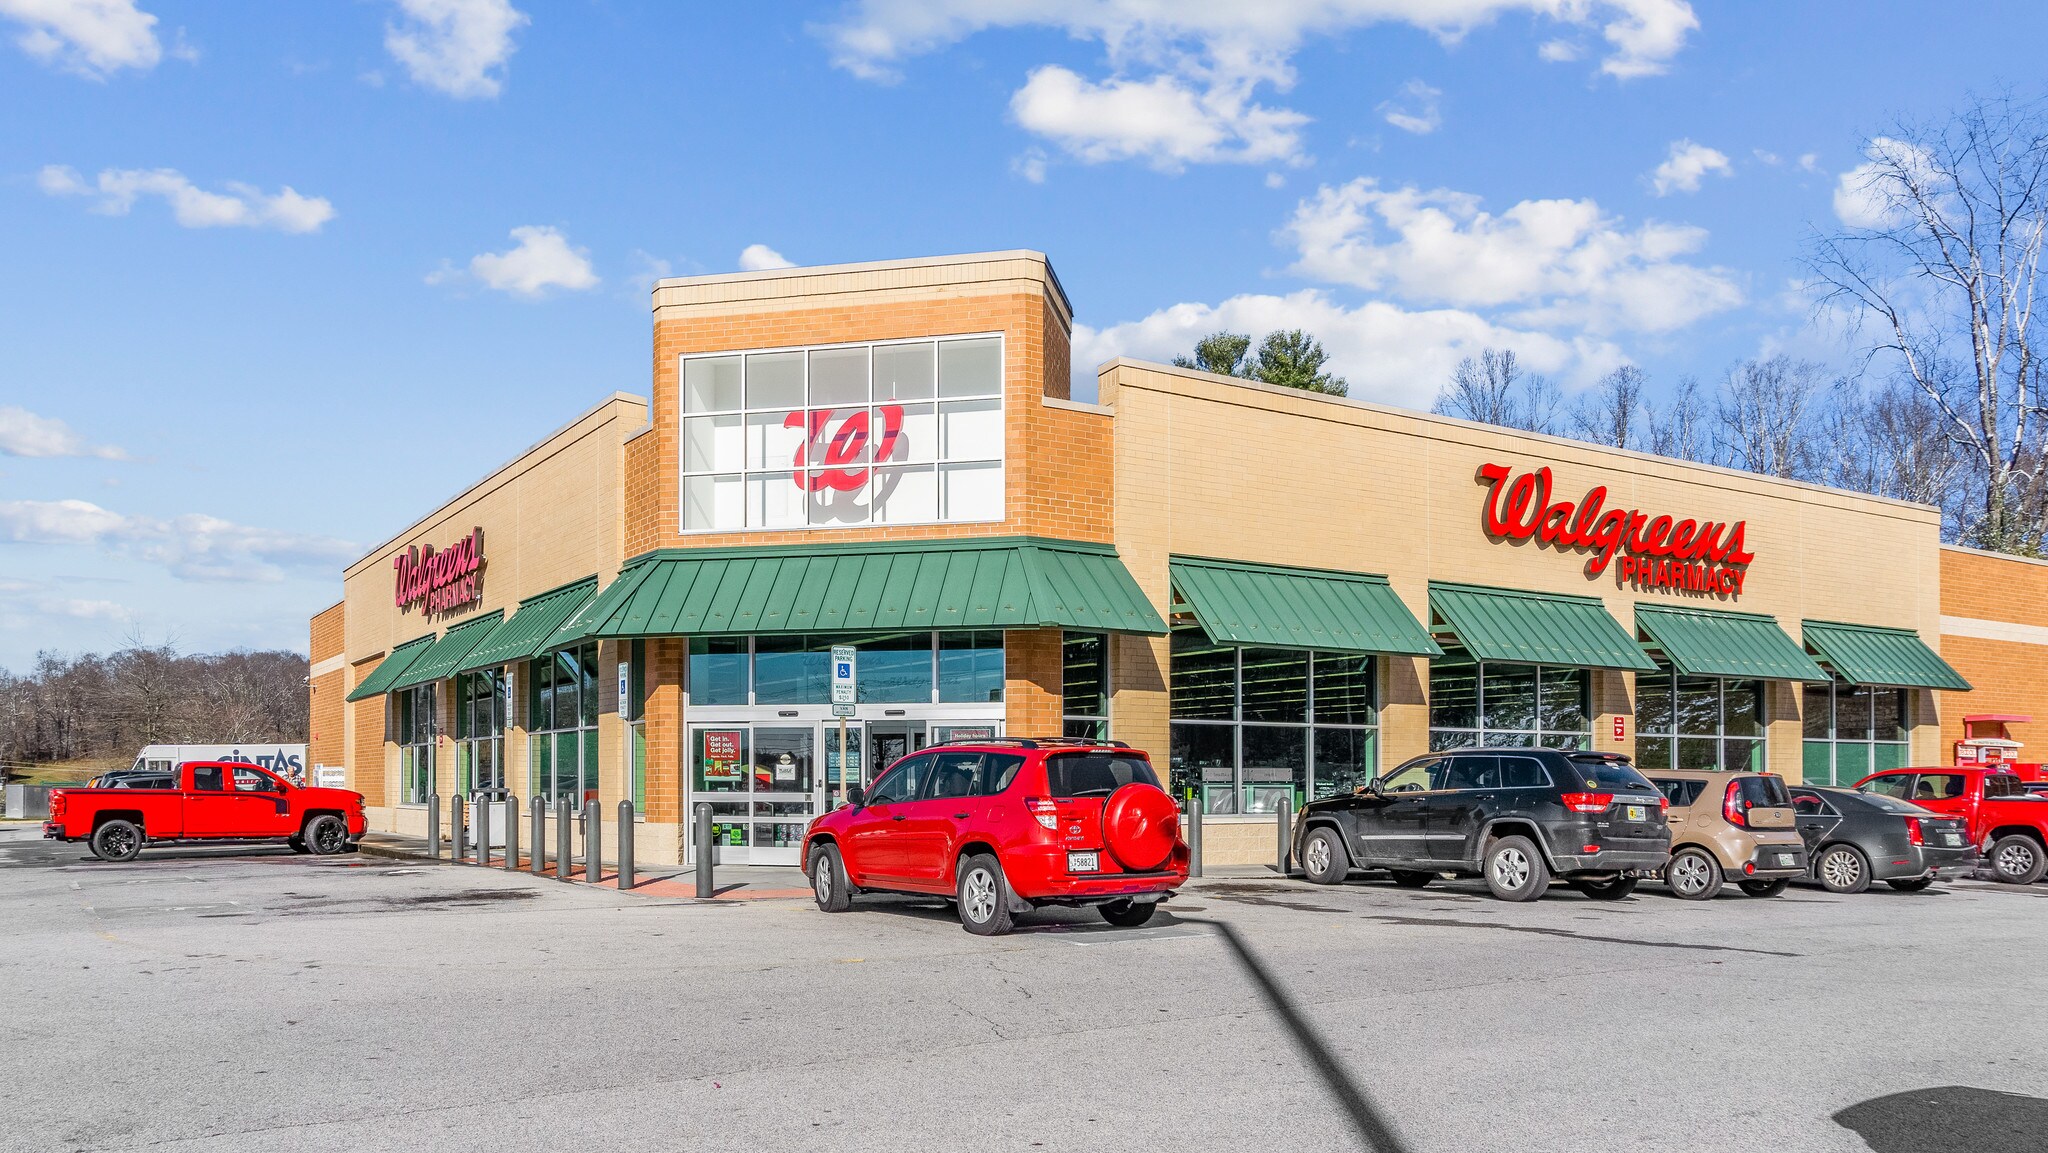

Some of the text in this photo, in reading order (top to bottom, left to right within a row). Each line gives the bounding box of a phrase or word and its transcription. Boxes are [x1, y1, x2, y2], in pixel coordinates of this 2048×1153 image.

[1477, 462, 1755, 574] Walgreens
[393, 526, 481, 616] Walgreens
[1621, 555, 1747, 596] PHARMACY
[429, 574, 477, 615] PHARMACY
[217, 747, 303, 776] INTAS
